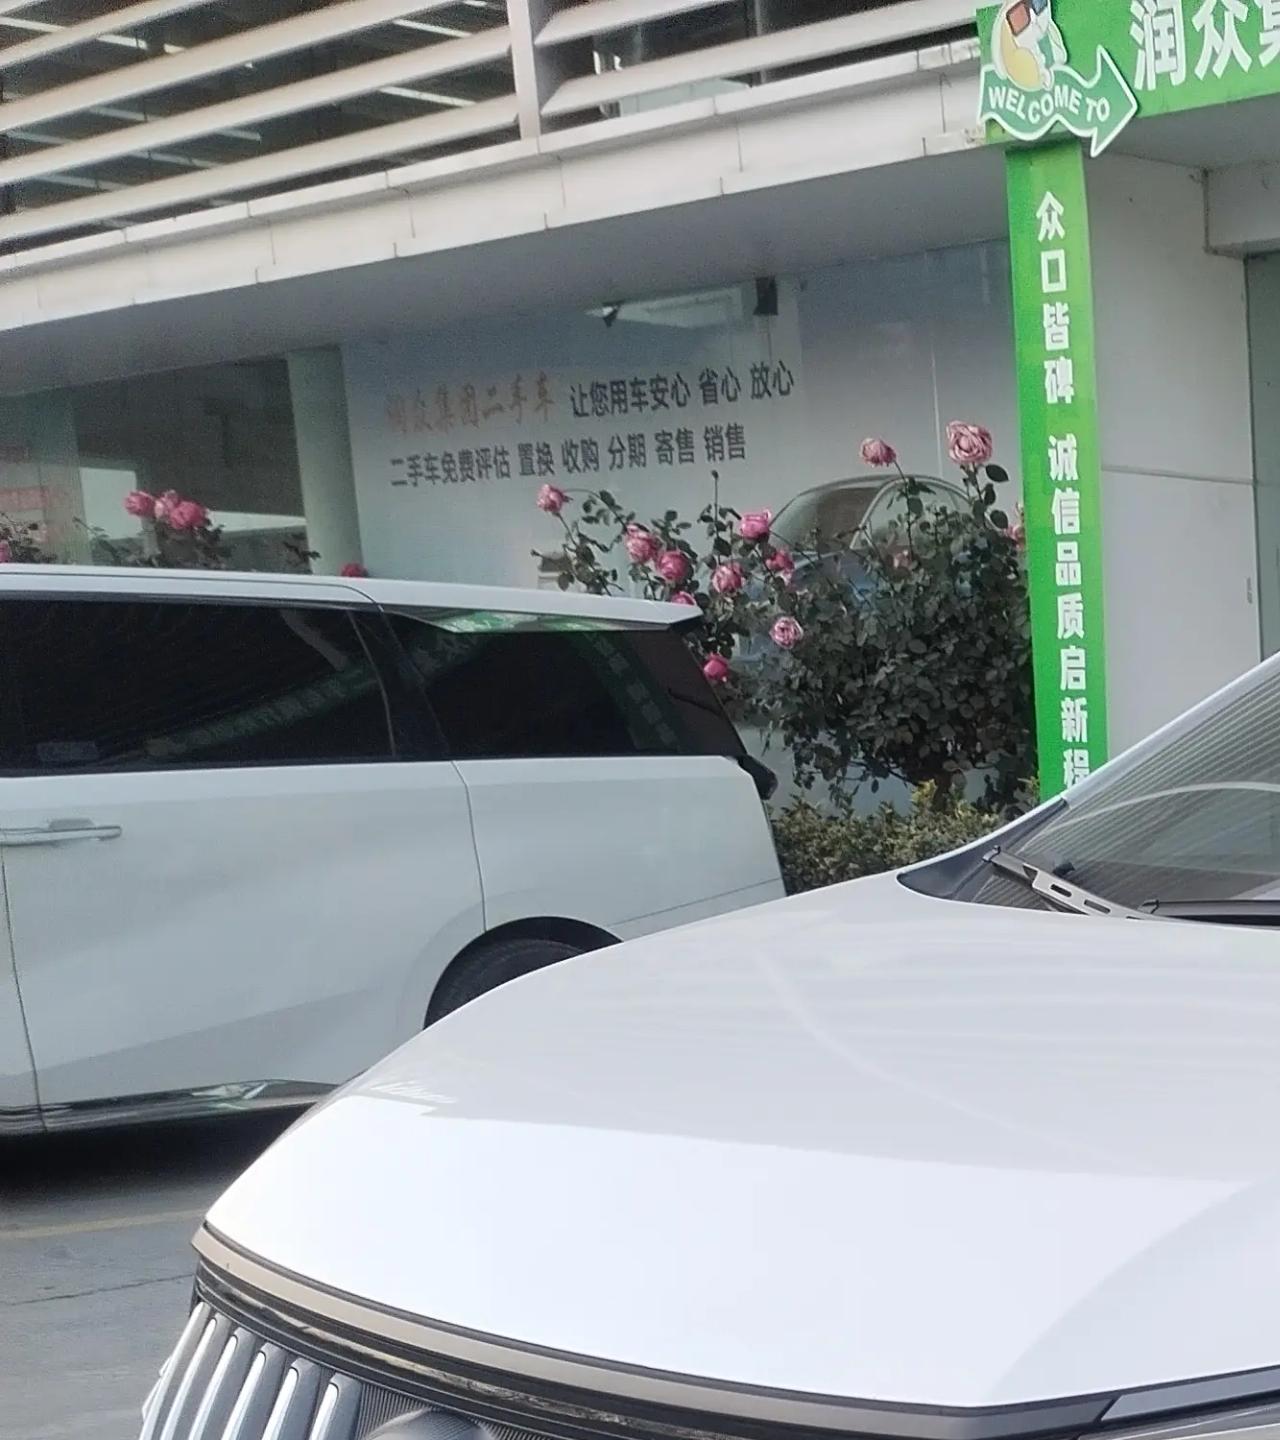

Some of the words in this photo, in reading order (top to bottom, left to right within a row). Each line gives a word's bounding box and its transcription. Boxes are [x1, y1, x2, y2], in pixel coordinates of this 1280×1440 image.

[988, 84, 1083, 124] WELCOME
[1086, 97, 1110, 123] TO
[1036, 191, 1075, 404] 众口皆碑
[570, 372, 691, 418] 让您用车安心
[699, 366, 742, 407] 省心
[749, 360, 795, 400] 放心
[390, 444, 511, 487] 二手车免费评估
[518, 441, 555, 477] 置换
[560, 437, 600, 474] 收购
[608, 433, 647, 471] 分期
[703, 422, 746, 462] 销售
